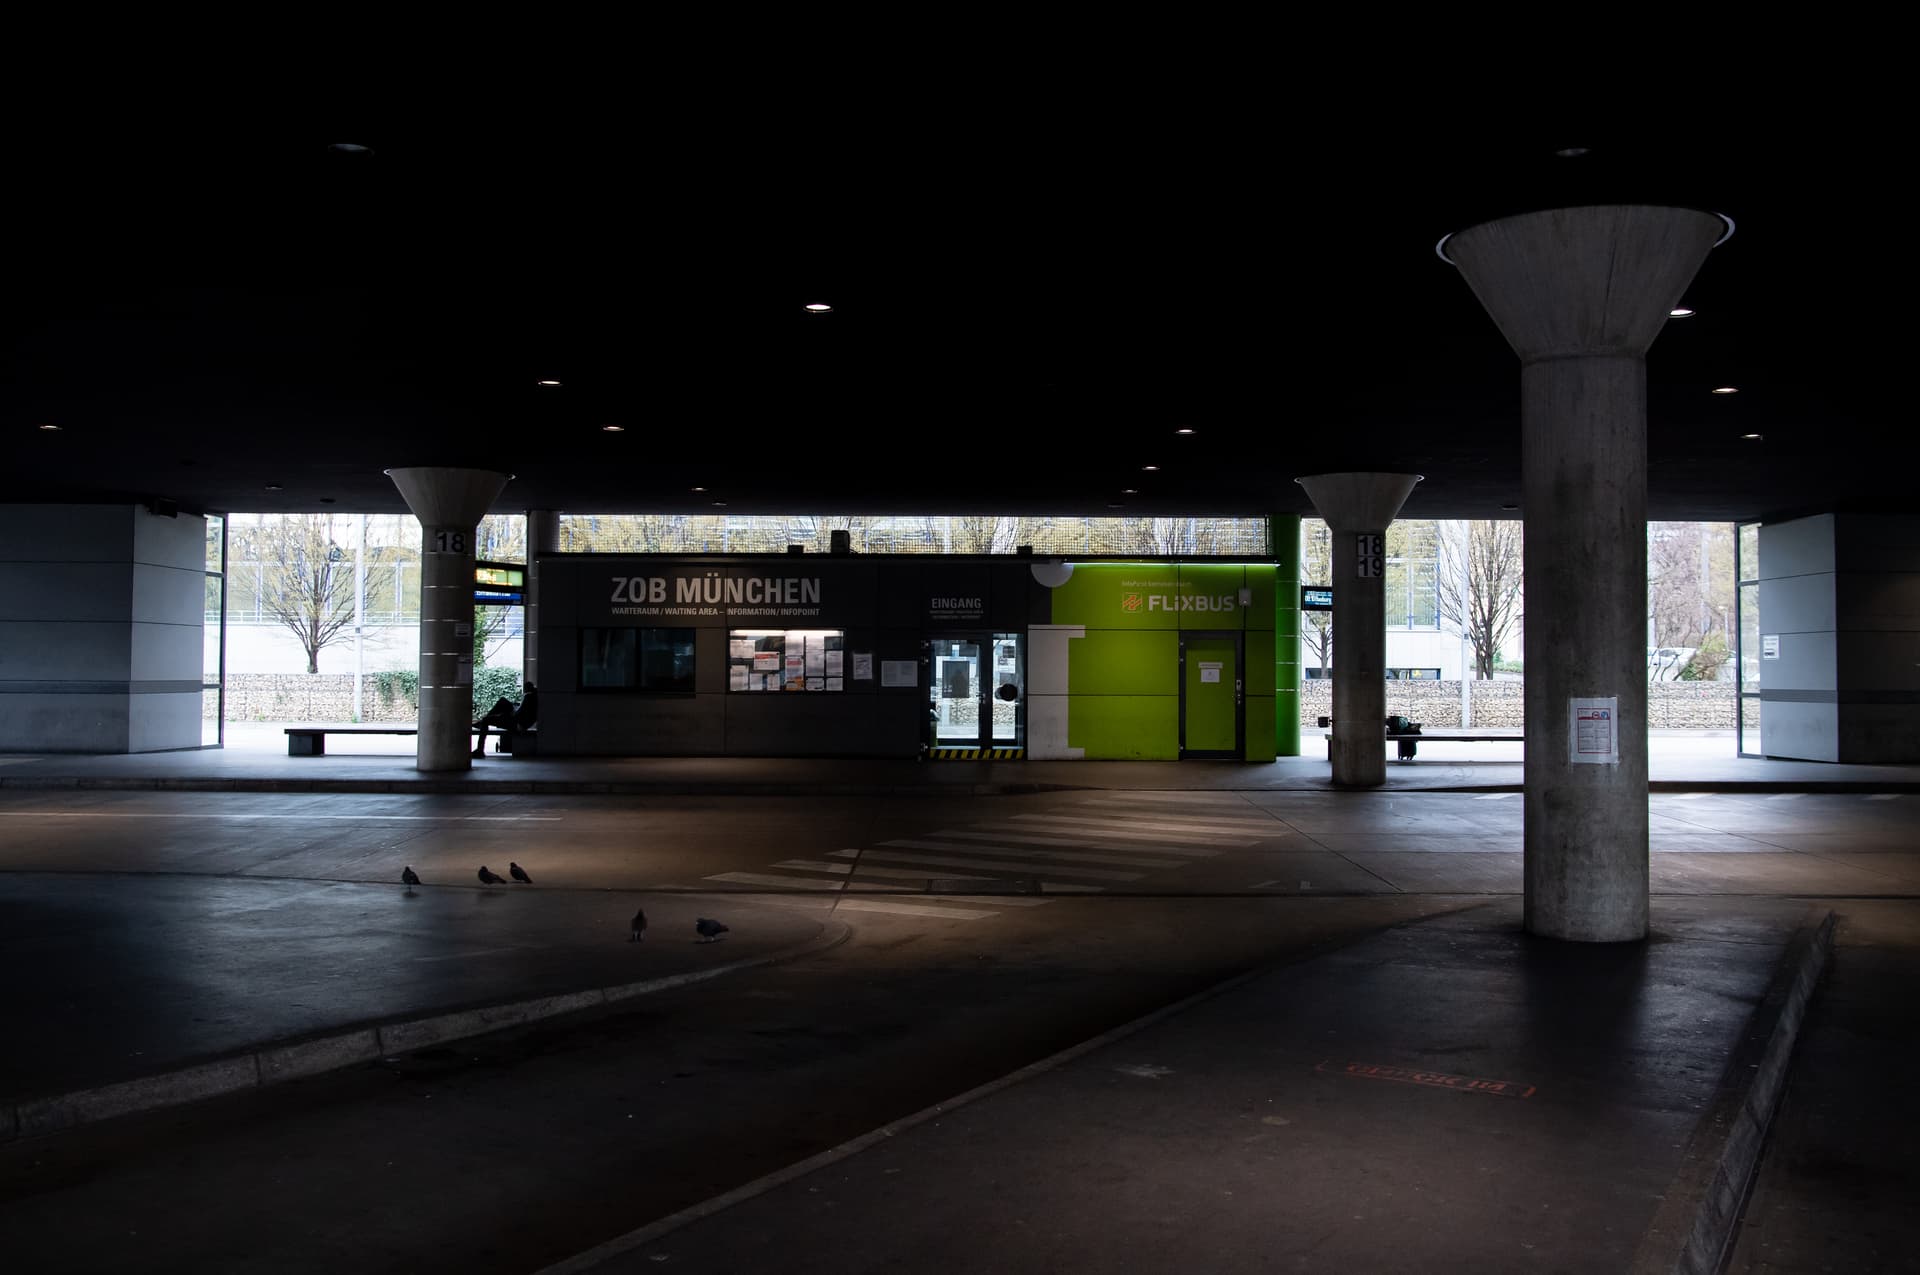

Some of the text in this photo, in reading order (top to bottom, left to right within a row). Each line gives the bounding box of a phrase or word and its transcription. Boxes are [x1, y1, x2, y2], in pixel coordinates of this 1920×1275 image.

[438, 532, 465, 553] 18
[1359, 536, 1383, 555] 18
[1359, 557, 1383, 577] 19
[610, 572, 821, 604] ZOB MÜNCHEN
[611, 607, 659, 616] WARTERAUM
[664, 607, 697, 616] WAITING
[698, 607, 718, 616] AREA
[727, 607, 775, 616] INFORMATION
[780, 608, 820, 616] INFOPOINT
[931, 597, 982, 609] EINGANG
